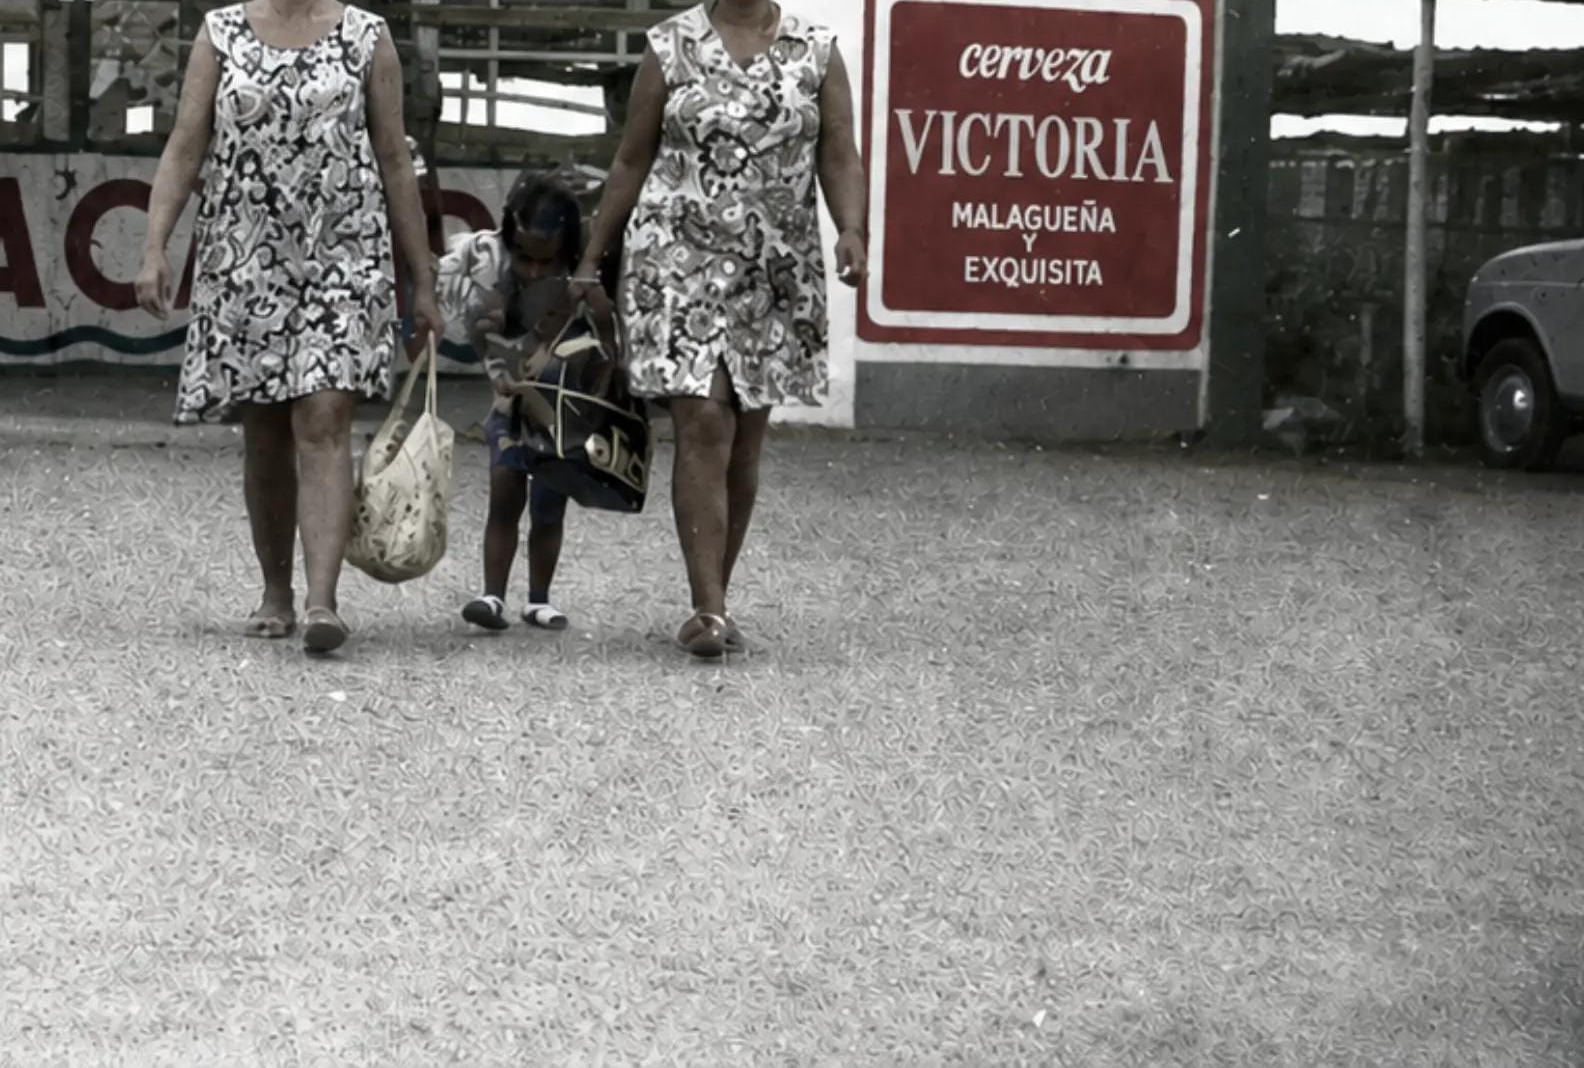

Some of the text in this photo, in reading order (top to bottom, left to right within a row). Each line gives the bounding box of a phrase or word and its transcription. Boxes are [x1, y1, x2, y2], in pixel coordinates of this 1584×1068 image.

[958, 43, 1112, 93] cerveza
[893, 108, 1174, 183] VICTORIA
[951, 199, 1116, 233] MALAGUEÑA
[1022, 232, 1038, 253] Y
[963, 255, 1103, 288] EXQUISITA
